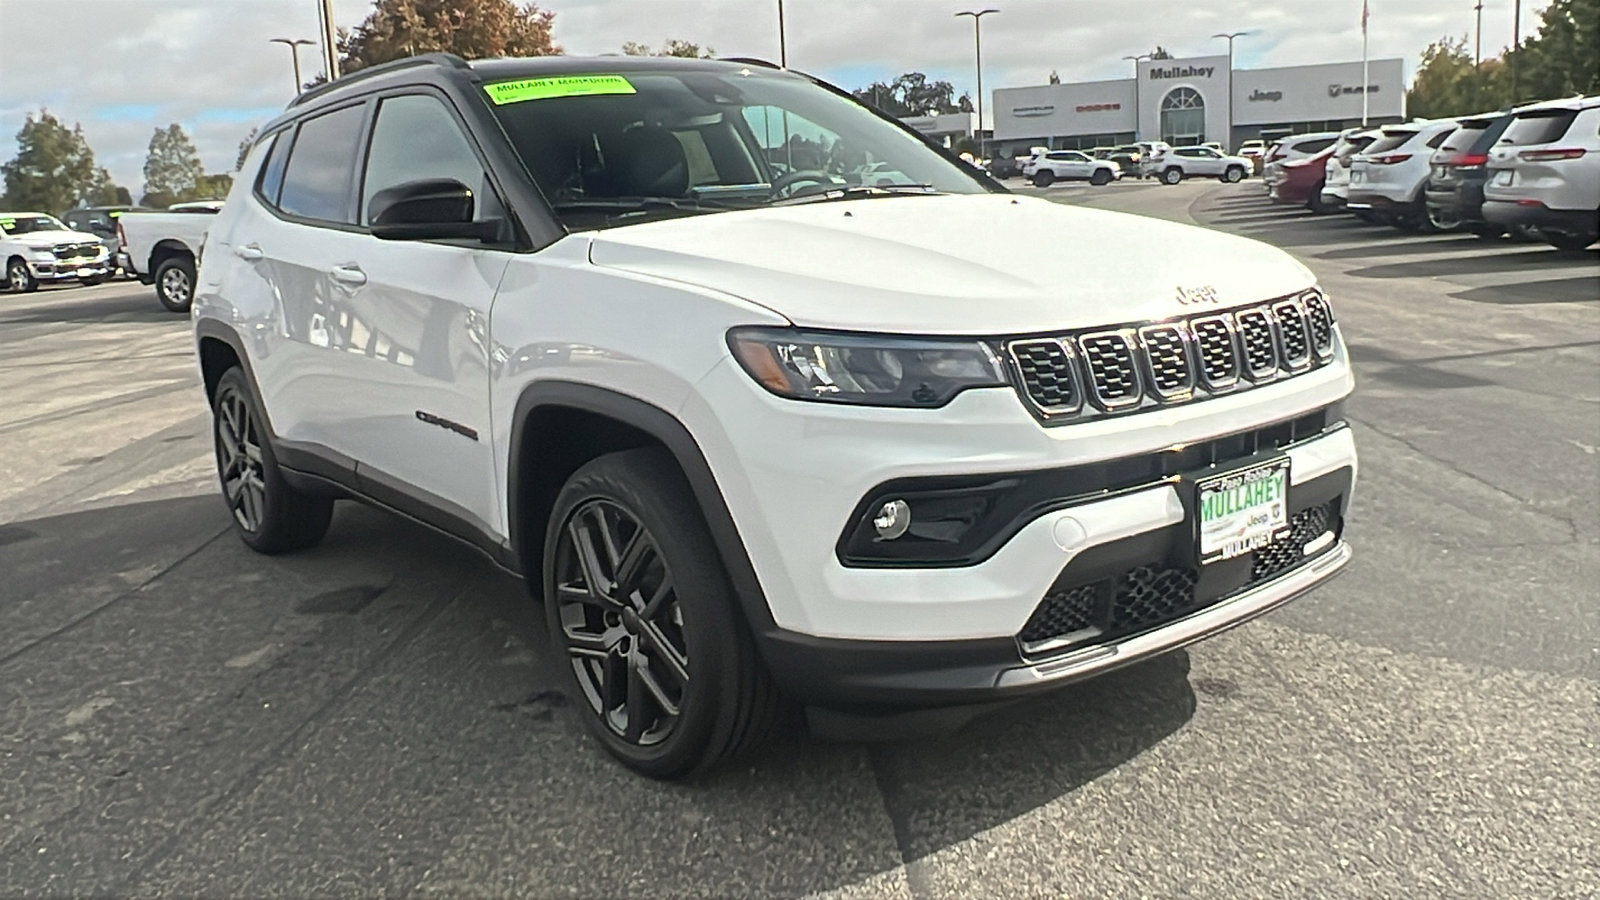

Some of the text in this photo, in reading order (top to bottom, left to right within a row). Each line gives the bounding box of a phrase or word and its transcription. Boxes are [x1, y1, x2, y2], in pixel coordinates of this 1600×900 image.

[1150, 66, 1214, 80] Mullahey
[496, 80, 554, 93] MULLAHEY
[1249, 89, 1282, 102] Jeep
[1176, 285, 1218, 306] Jeep
[1201, 475, 1284, 522] MULLAHEY
[1247, 513, 1268, 528] Jeep
[1222, 530, 1274, 559] MULLAHEY
